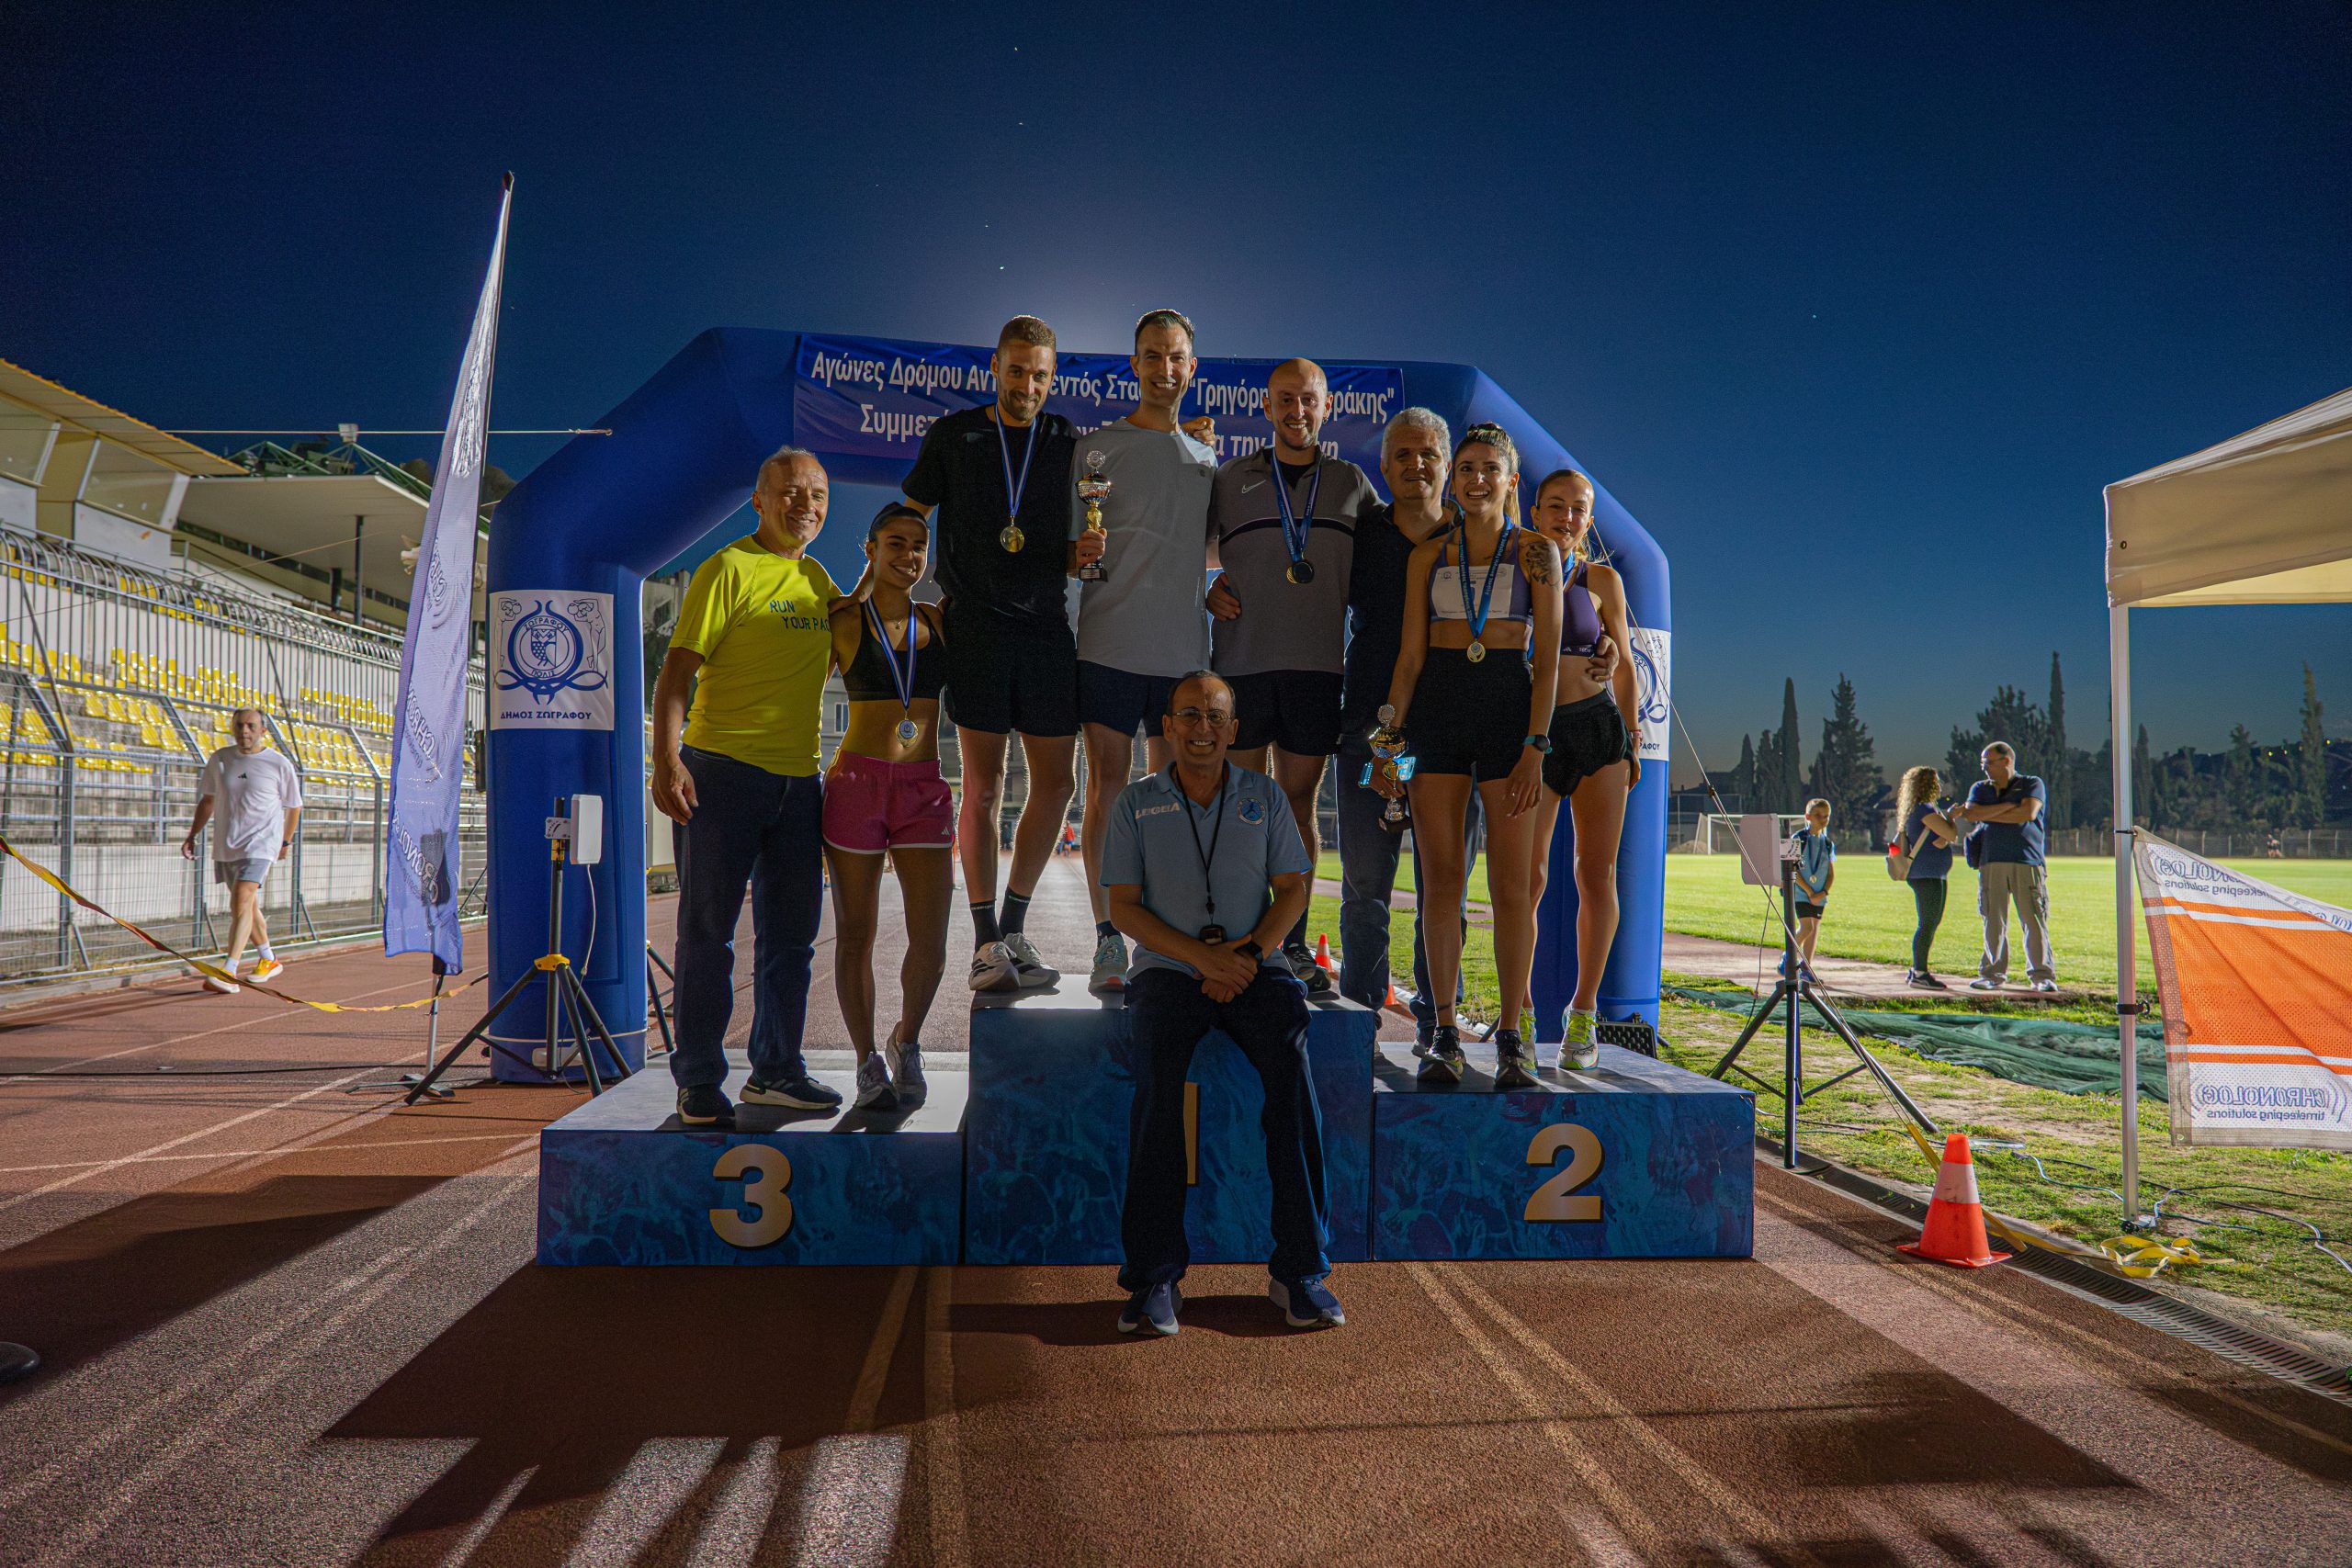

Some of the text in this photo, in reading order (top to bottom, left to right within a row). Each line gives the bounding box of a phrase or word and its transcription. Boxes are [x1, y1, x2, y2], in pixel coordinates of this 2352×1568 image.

[810, 351, 885, 392] Αγώνες
[888, 356, 962, 396] Δρόμου
[769, 599, 796, 614] RUN
[782, 615, 811, 631] YOUR
[500, 711, 592, 720] ΔΗΜΟΣ ΖΩΓΡΑΦΟΥ
[1524, 1123, 1604, 1224] 2
[711, 1145, 793, 1246] 3
